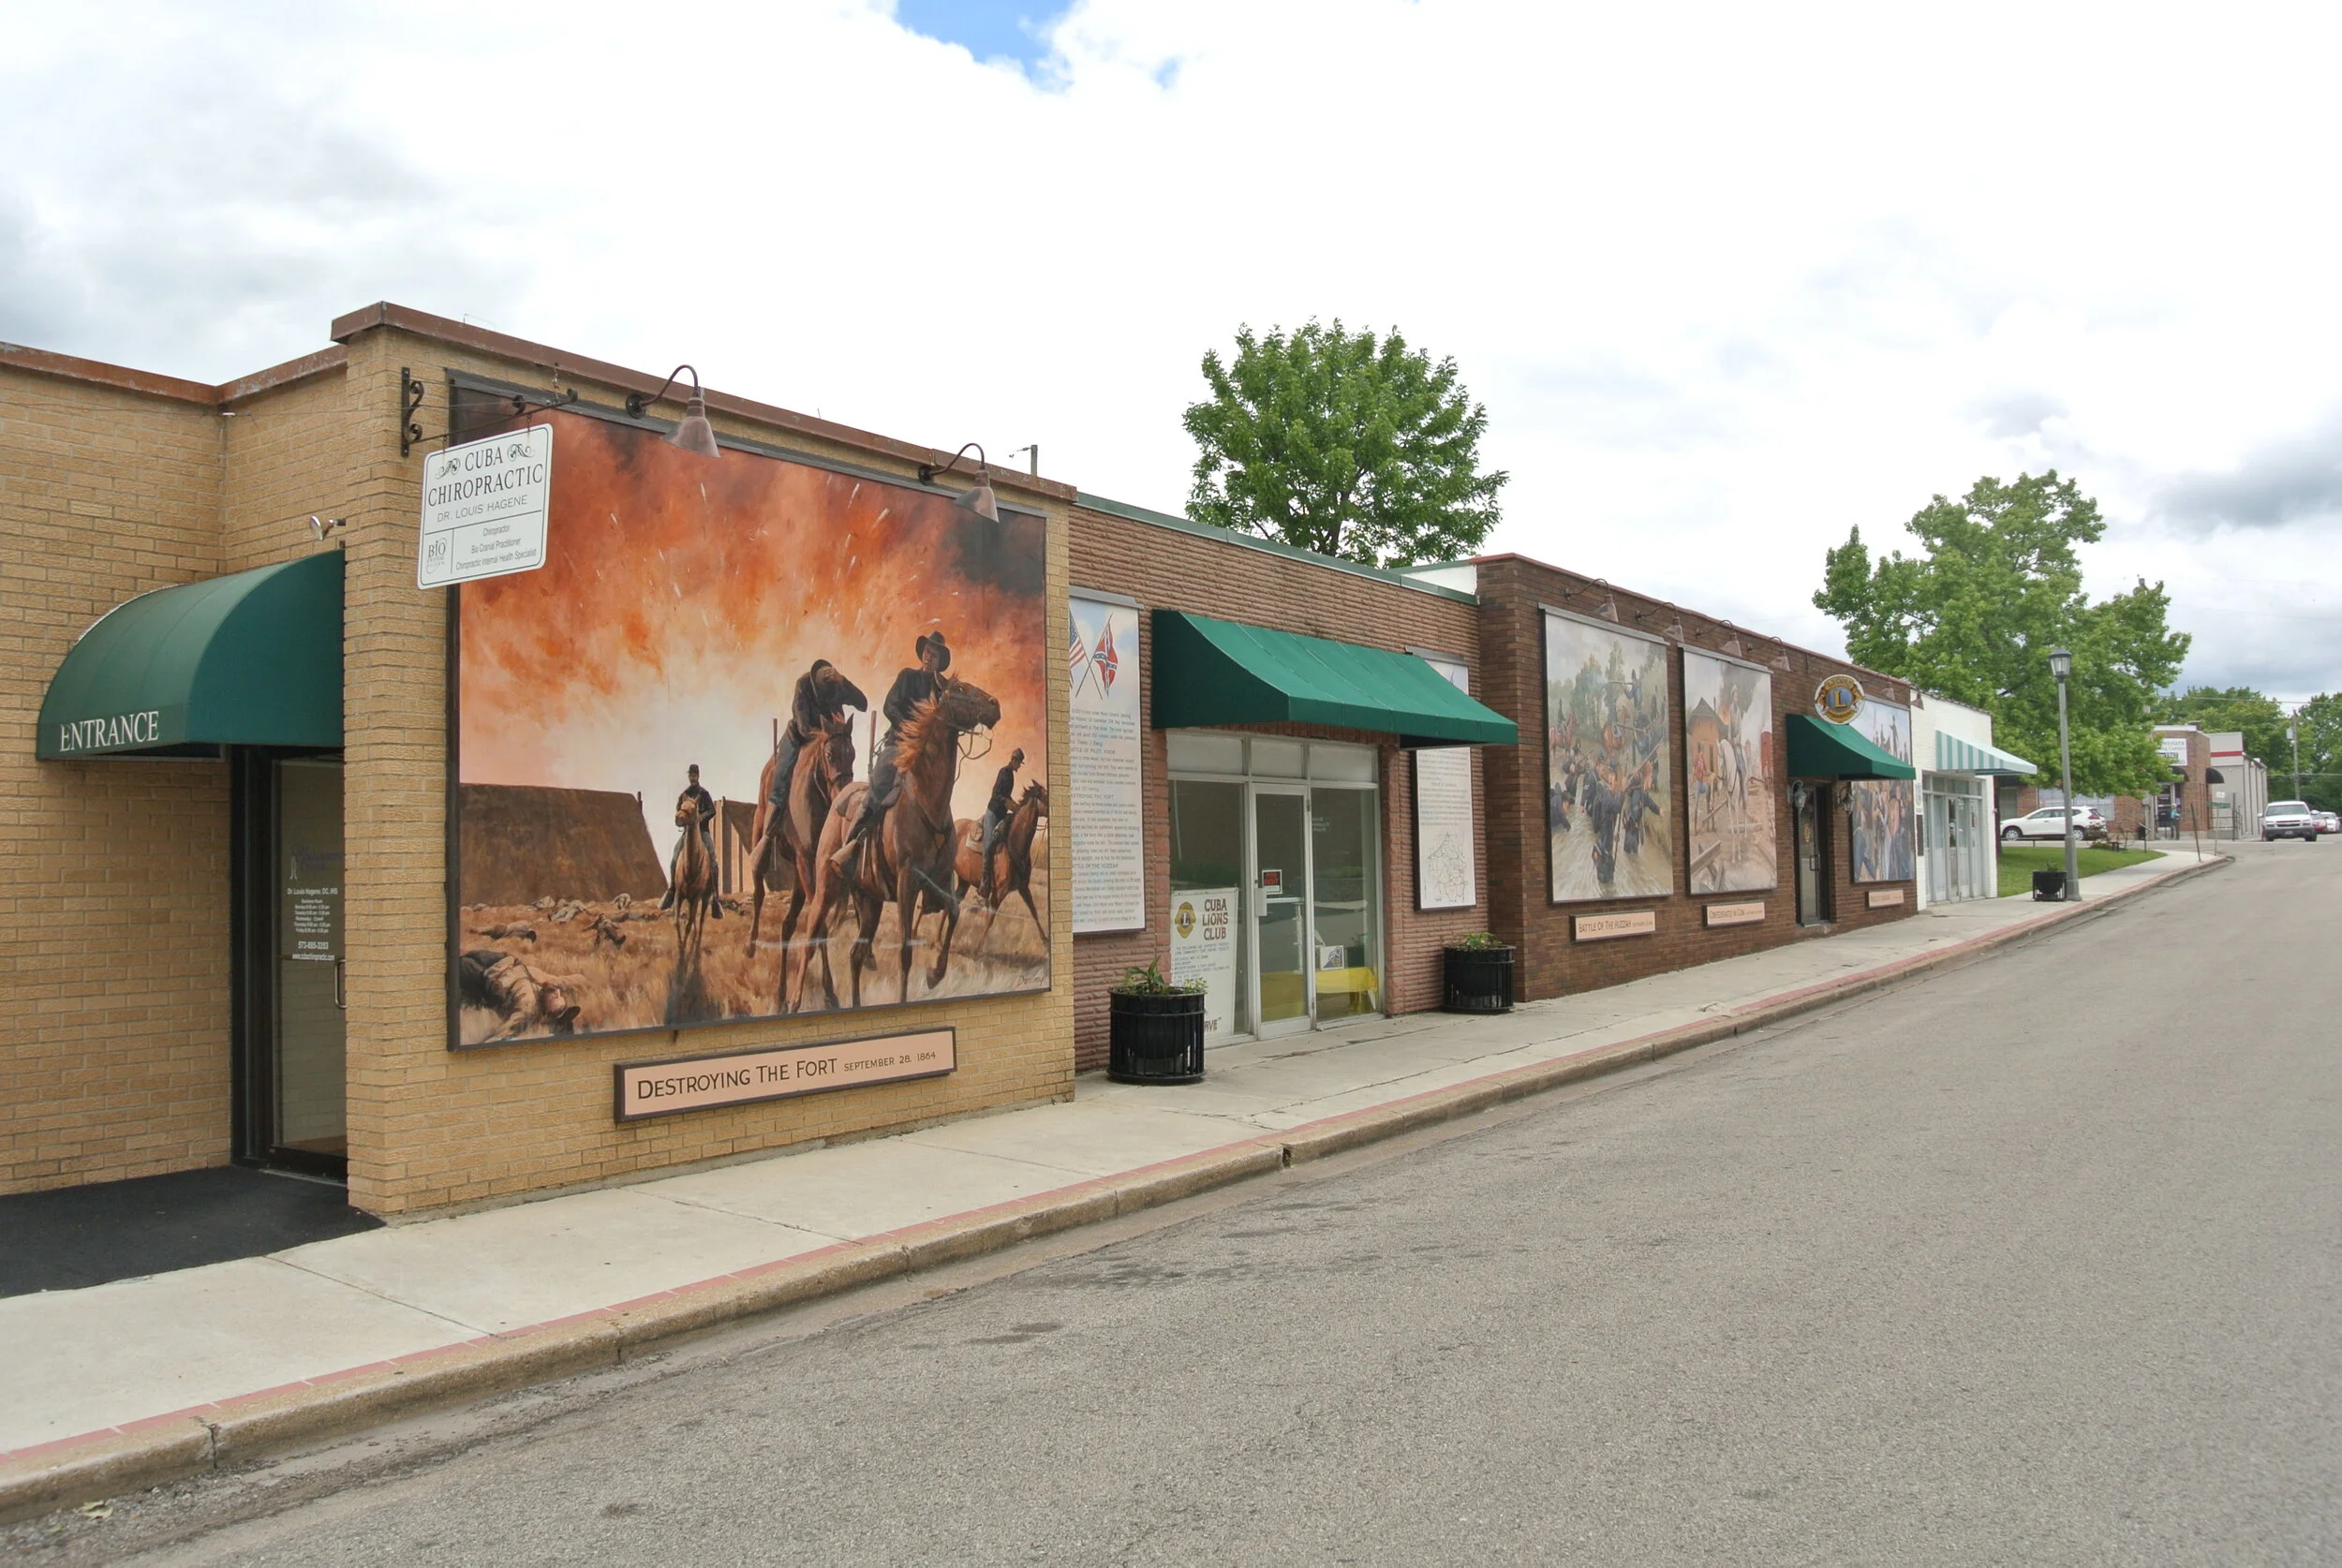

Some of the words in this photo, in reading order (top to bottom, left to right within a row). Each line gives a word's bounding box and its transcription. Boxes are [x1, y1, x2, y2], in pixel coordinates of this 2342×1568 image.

[465, 446, 503, 471] CUBA
[428, 464, 543, 507] CHIROPRACTIC
[437, 511, 453, 523] DR.
[455, 504, 483, 519] LOUIS
[487, 495, 527, 512] HAGENE
[1834, 690, 1847, 708] L
[59, 711, 159, 751] ENTRANCE
[1204, 898, 1227, 911] CUBA
[1202, 912, 1229, 926] LIONS
[1204, 926, 1226, 941] CLUB
[637, 1069, 750, 1100] DESTROYING
[756, 1064, 790, 1084] THE
[796, 1058, 837, 1078] FORT
[844, 1057, 895, 1072] SEPTEMBER
[917, 1051, 936, 1061] 1864
